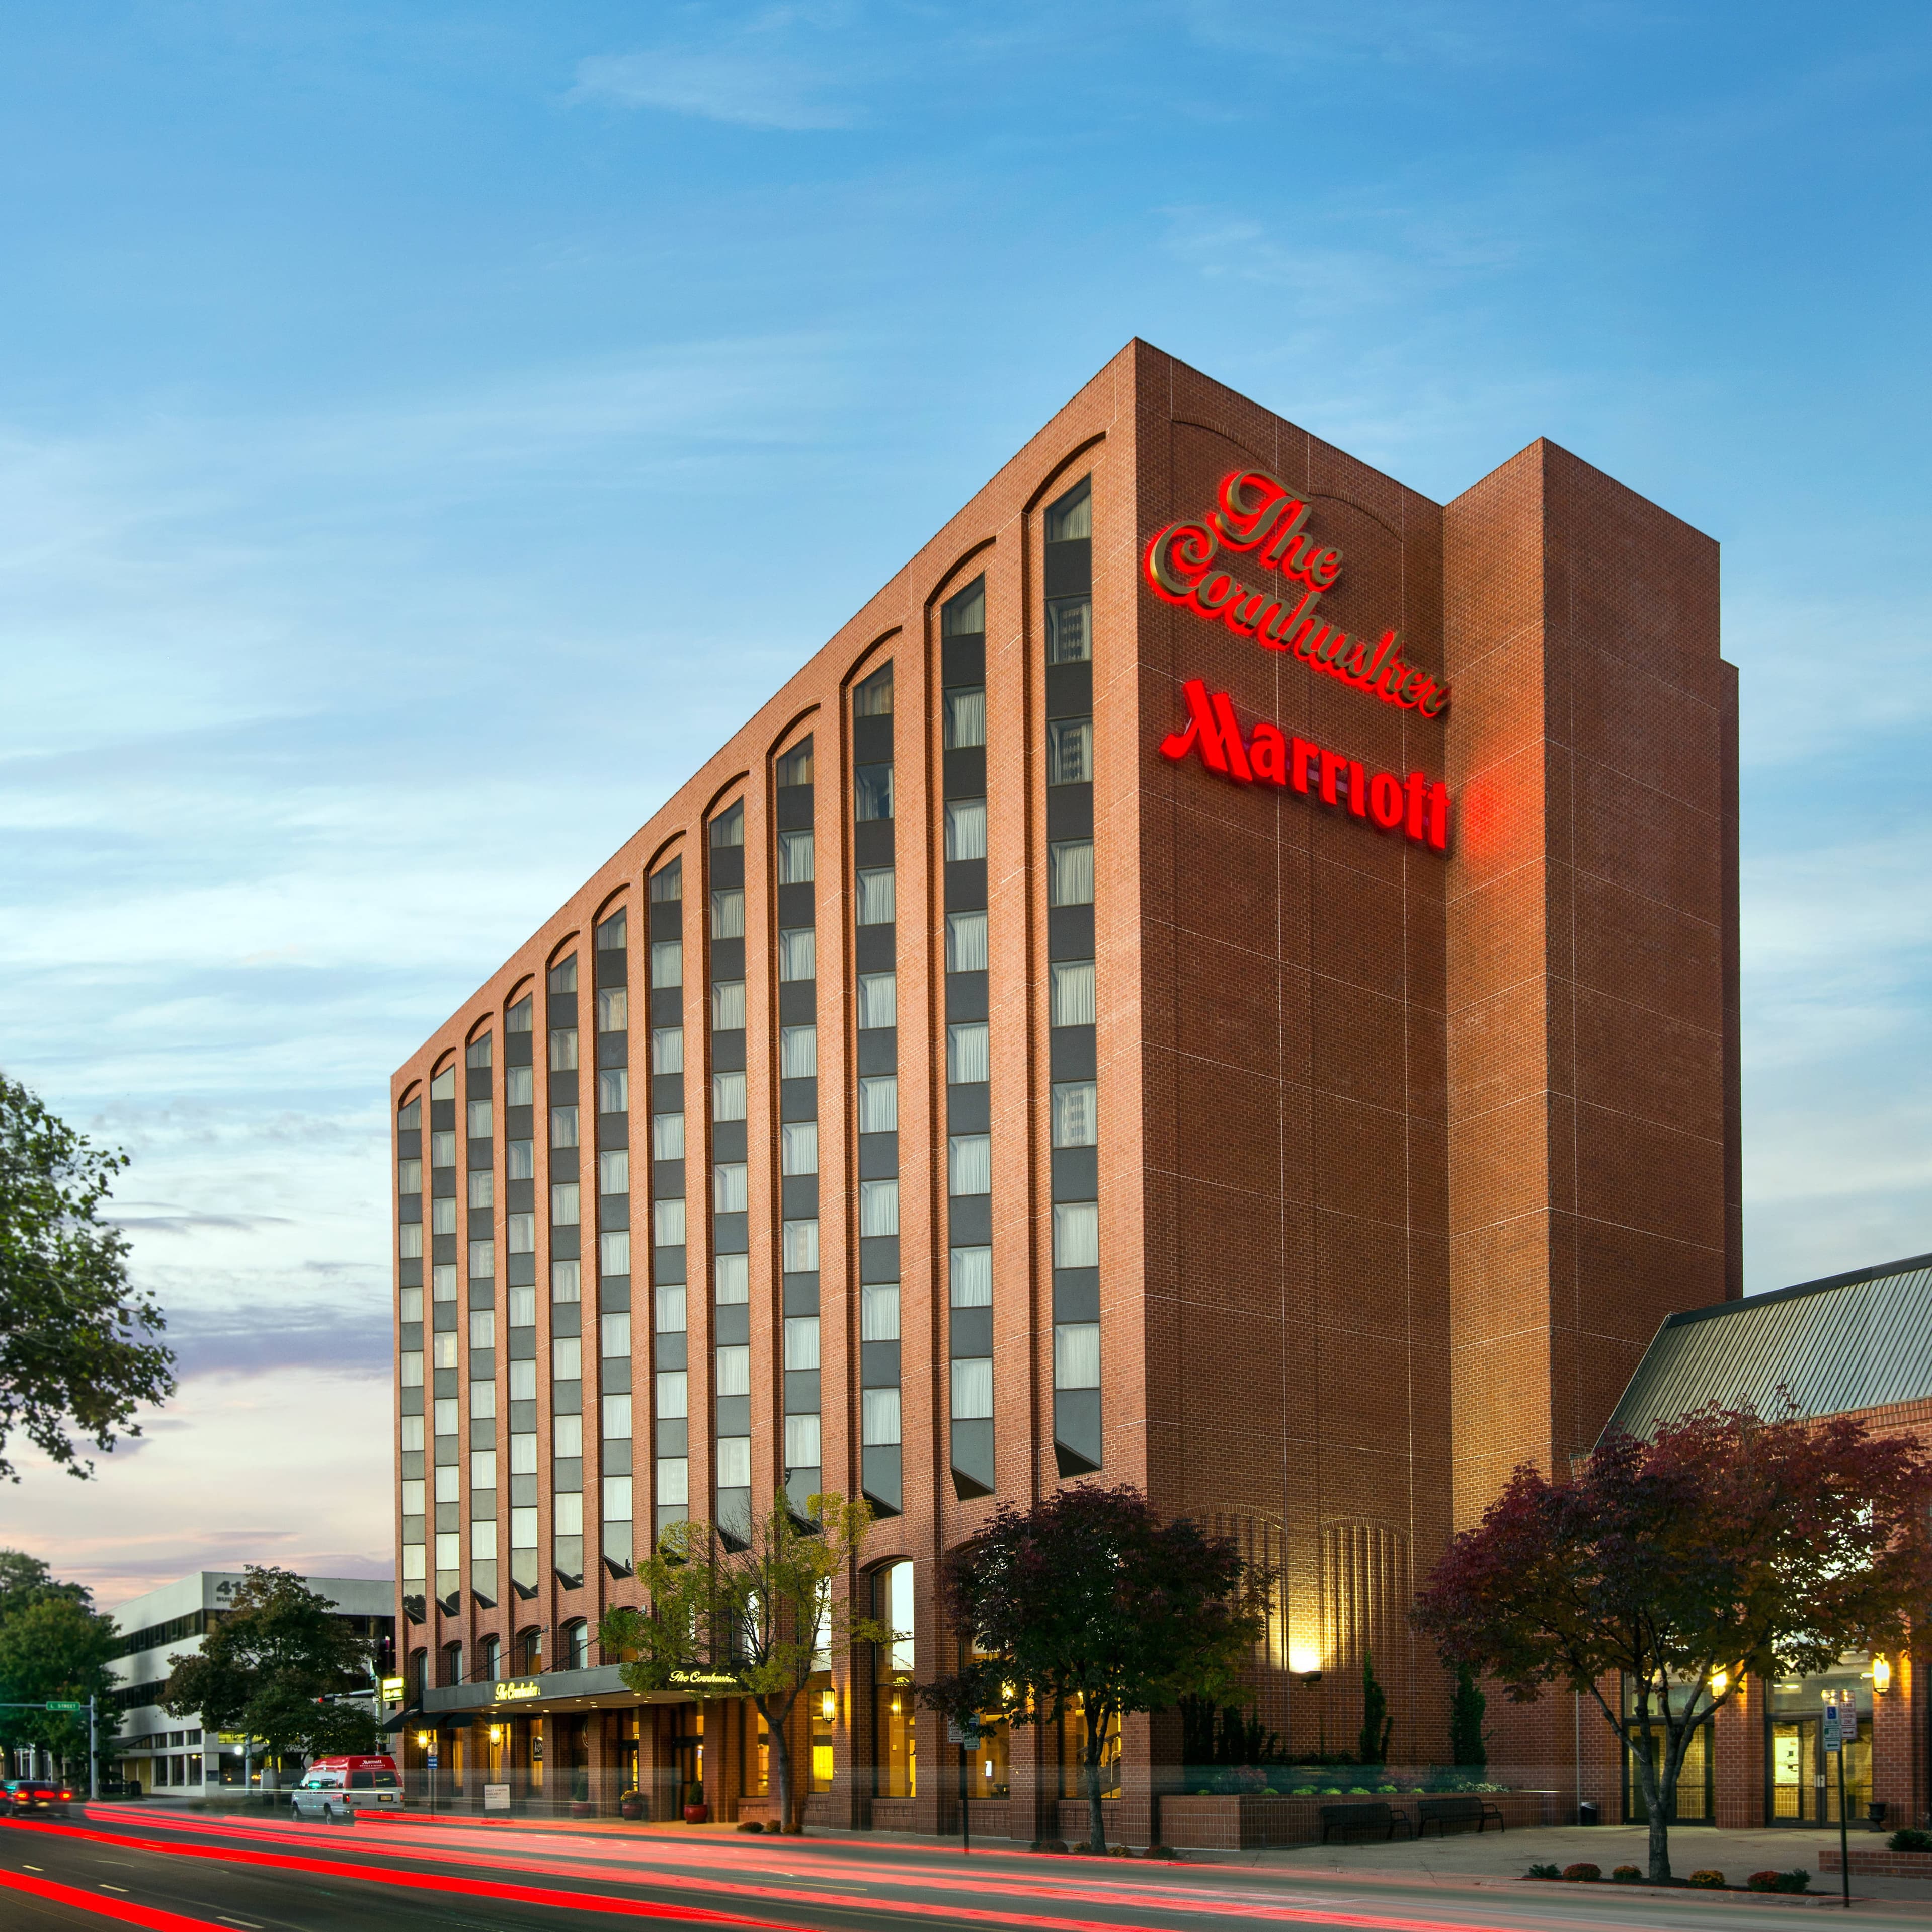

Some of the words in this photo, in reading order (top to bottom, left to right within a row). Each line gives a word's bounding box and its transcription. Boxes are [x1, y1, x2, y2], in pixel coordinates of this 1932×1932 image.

[1213, 469, 1344, 588] The
[1146, 520, 1451, 716] Cornhusker
[1159, 678, 1451, 850] Marriott
[669, 1670, 689, 1682] The
